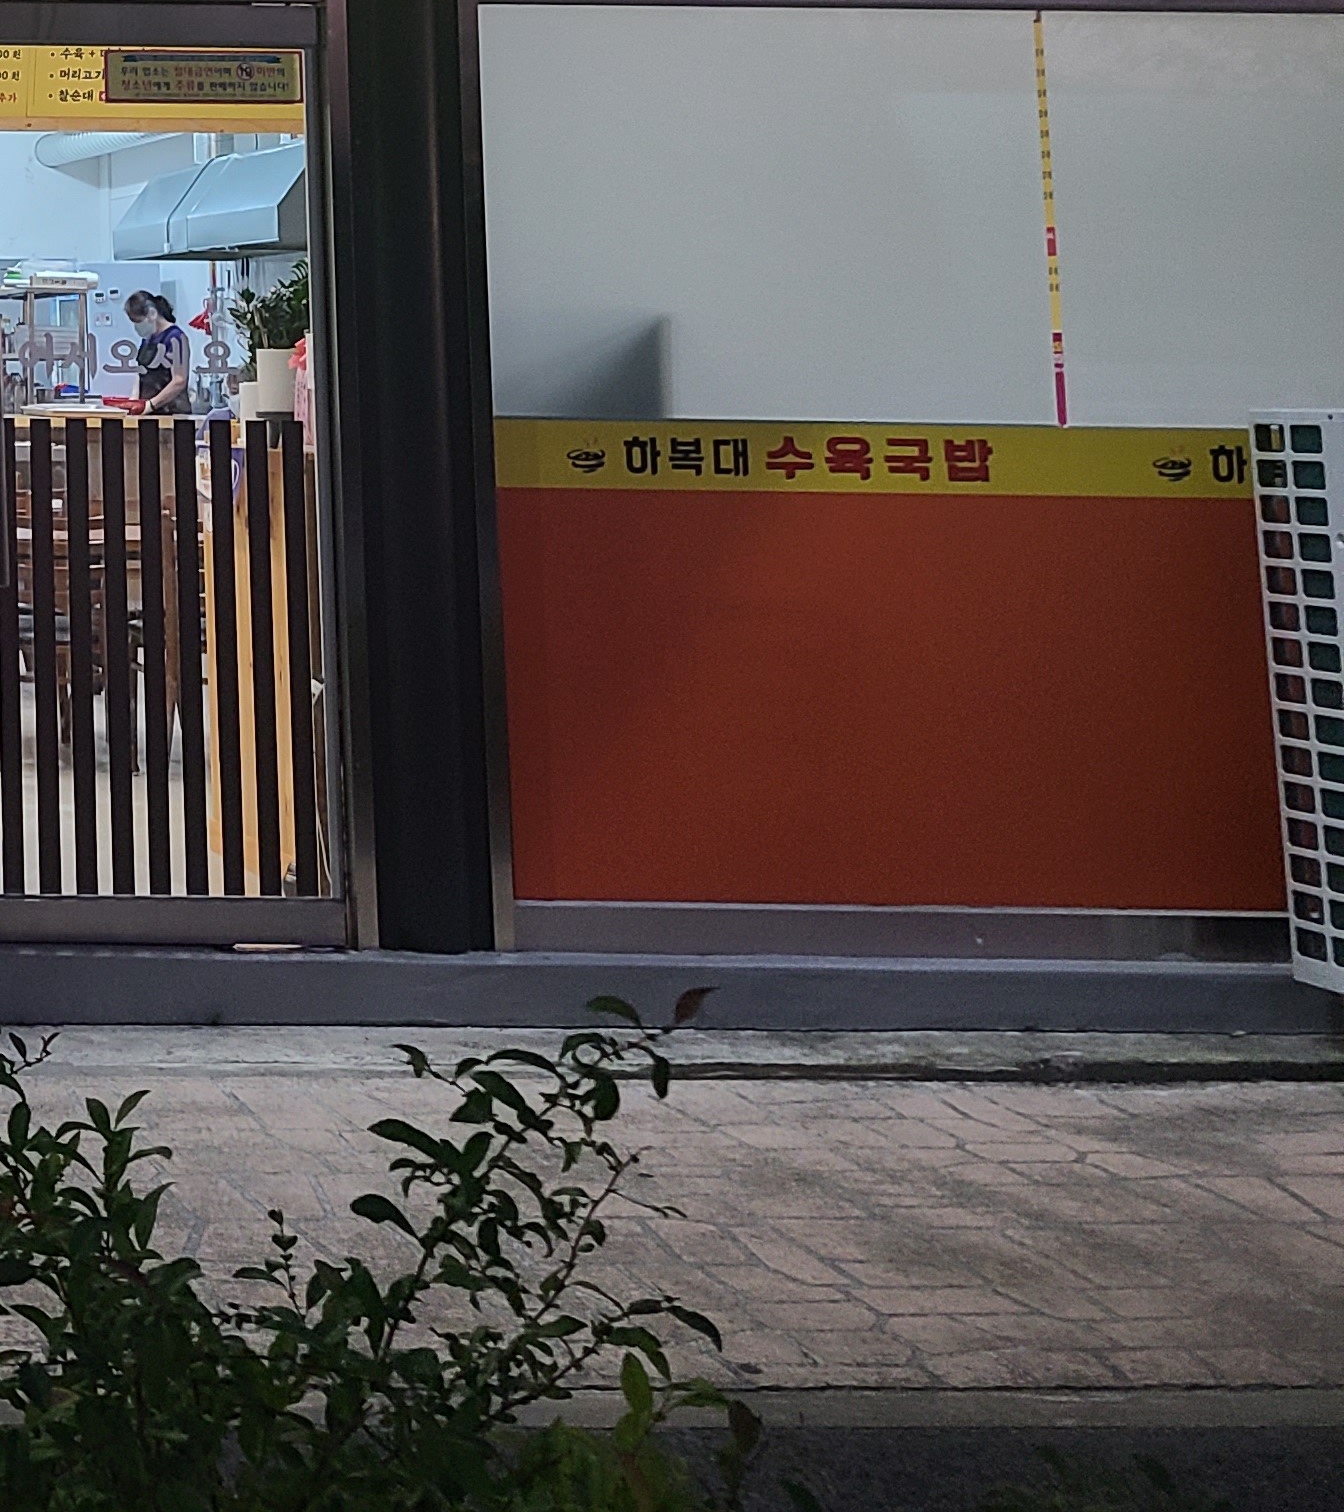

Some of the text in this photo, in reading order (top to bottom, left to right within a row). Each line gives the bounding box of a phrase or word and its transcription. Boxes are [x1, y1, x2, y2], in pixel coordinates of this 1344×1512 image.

[59, 47, 85, 60] 수육
[59, 68, 105, 81] 머리고기
[621, 435, 994, 484] 하복대 수육국밥
